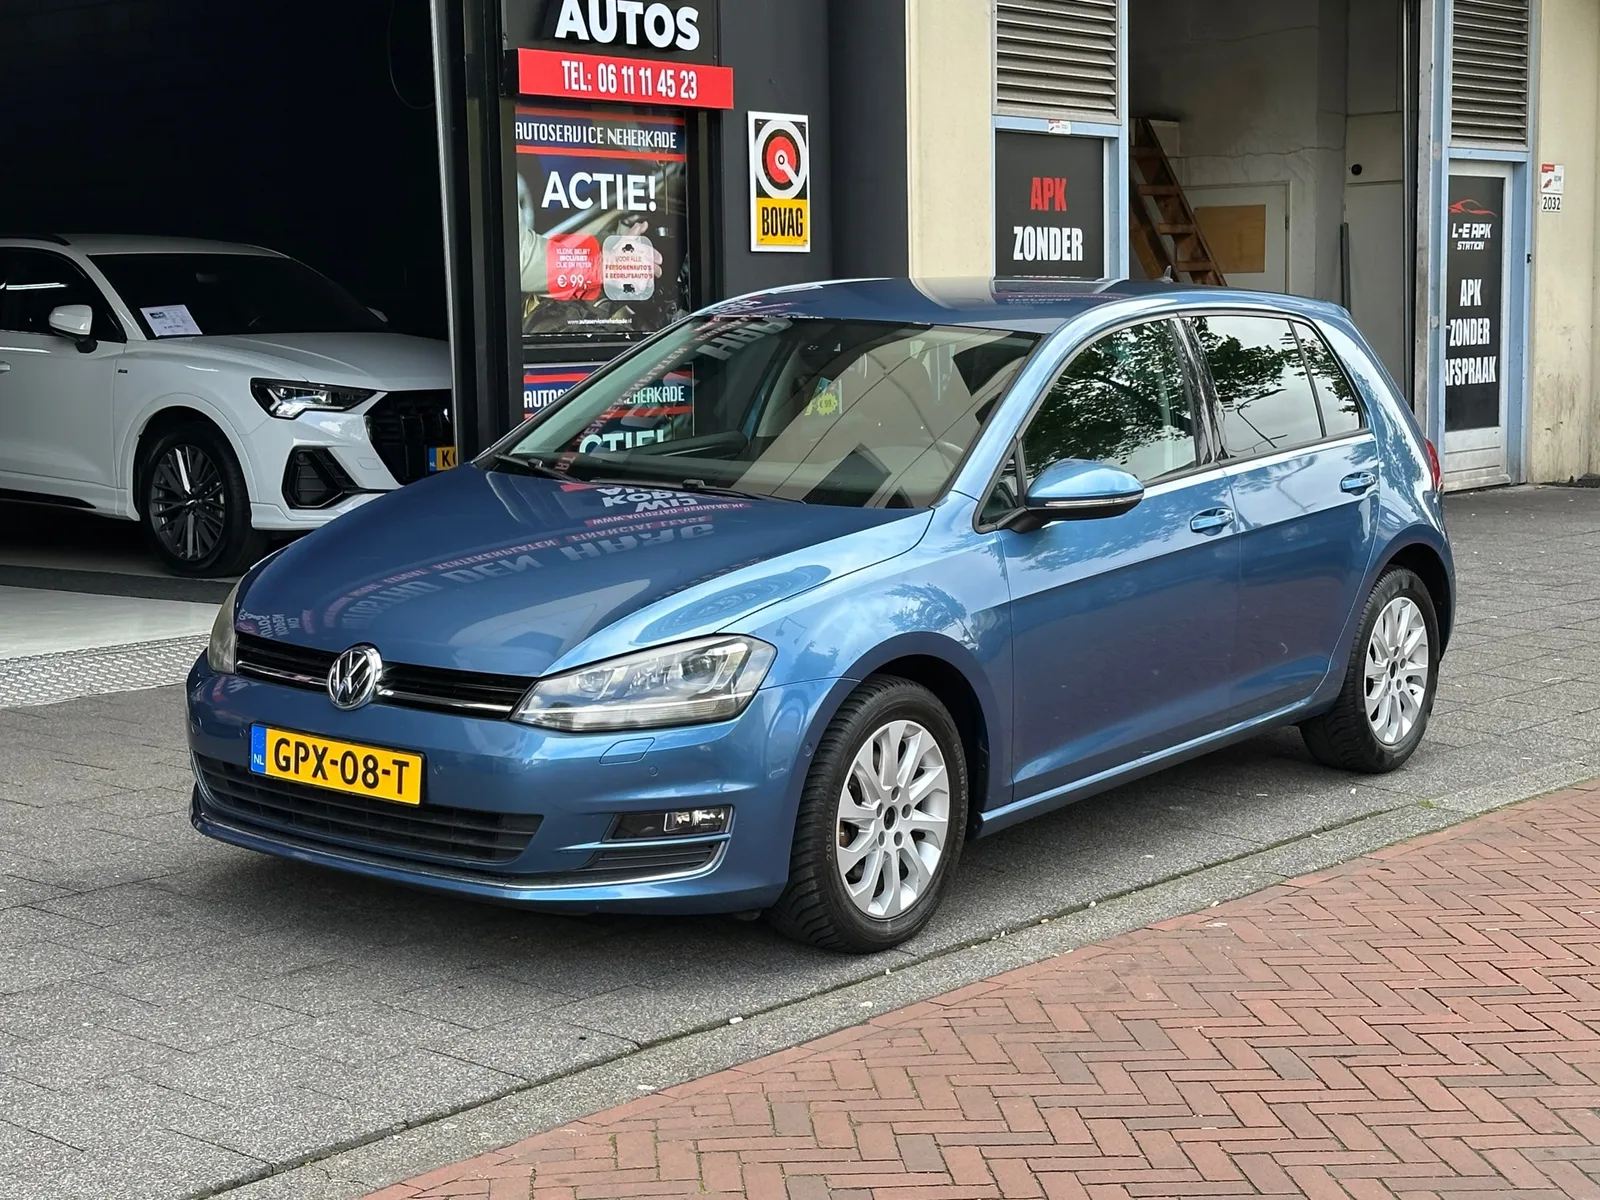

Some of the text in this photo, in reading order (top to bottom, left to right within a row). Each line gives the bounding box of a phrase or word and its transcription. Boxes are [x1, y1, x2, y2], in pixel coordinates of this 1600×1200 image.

[554, 0, 700, 50] AUTOS
[562, 60, 697, 99] TEL: 06 11 11 45 23
[516, 122, 677, 149] AUTOSERVICE NEHERKADE
[541, 171, 657, 212] ACTIE!
[1030, 177, 1067, 211] APK
[1543, 196, 1560, 210] 2032
[762, 207, 803, 237] BOVAG
[1452, 223, 1492, 238] L-E APK
[1013, 226, 1083, 261] ZONDER
[1457, 241, 1484, 250] STATION
[557, 274, 592, 289] € 99,-
[1460, 279, 1482, 306] APK
[1450, 318, 1490, 346] ZONDER
[254, 754, 264, 766] NL
[274, 737, 409, 795] GPX-08-T
